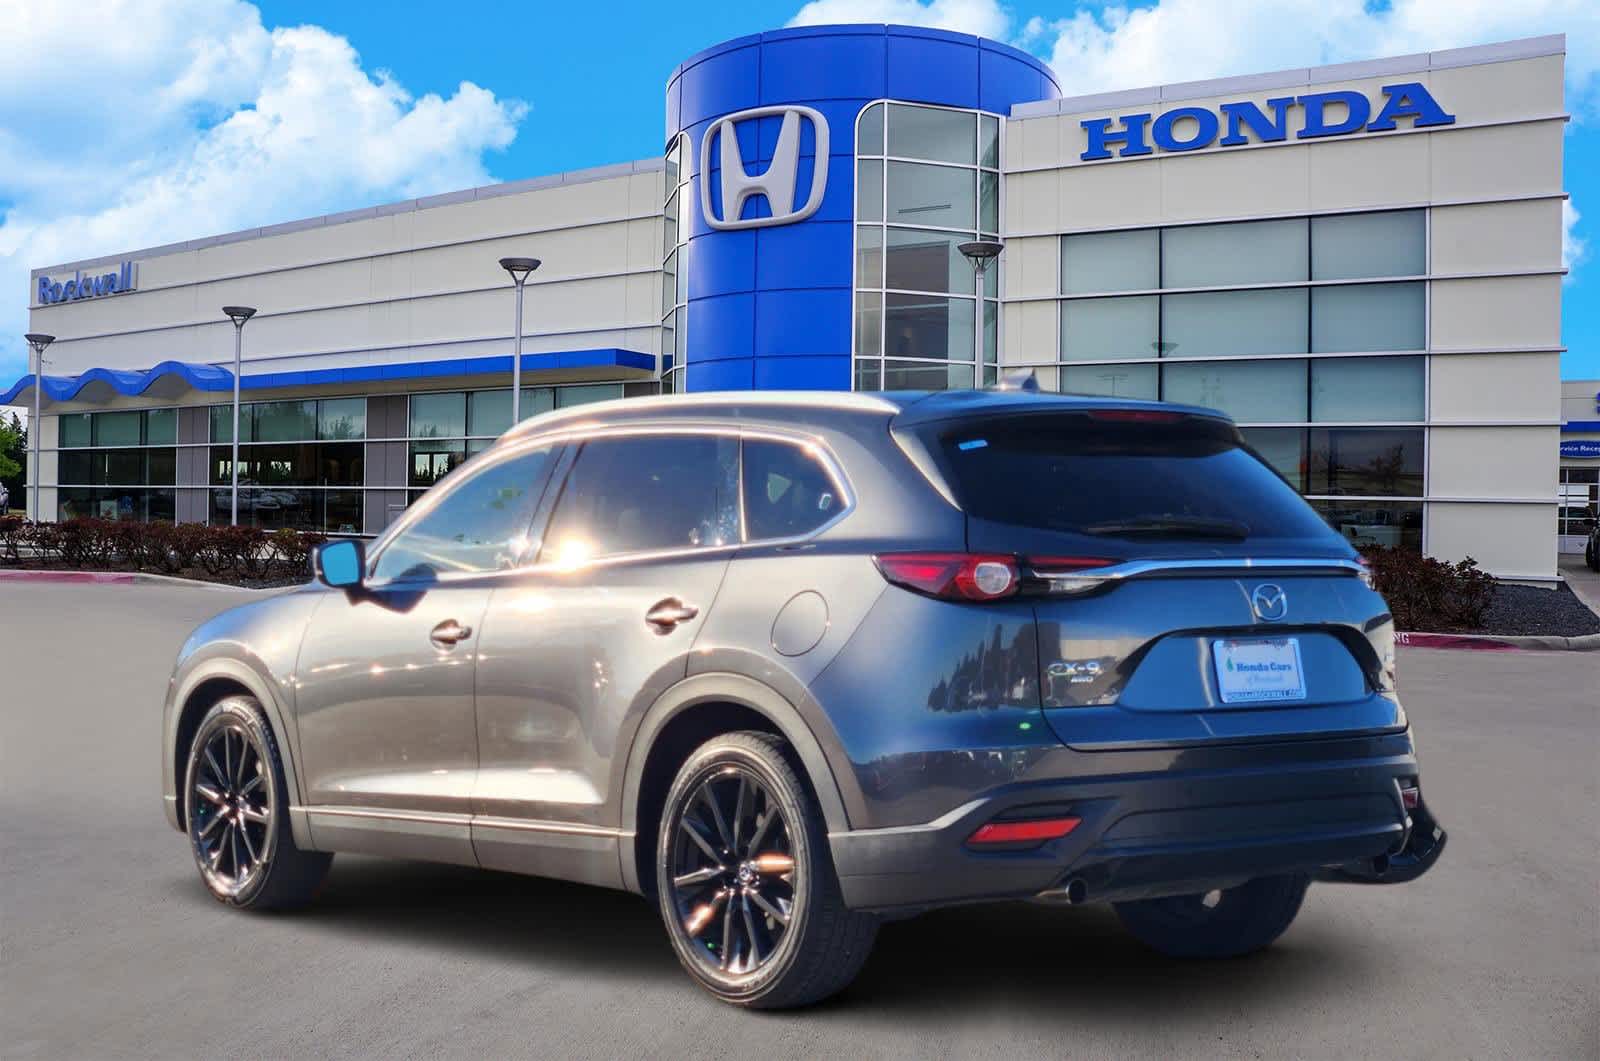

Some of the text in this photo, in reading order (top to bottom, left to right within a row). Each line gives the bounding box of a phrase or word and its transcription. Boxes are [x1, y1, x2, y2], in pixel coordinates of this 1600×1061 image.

[1080, 82, 1455, 161] HONDA
[38, 260, 132, 304] Rockwall
[1048, 662, 1102, 675] CX-9
[1236, 661, 1292, 673] Honda Cars
